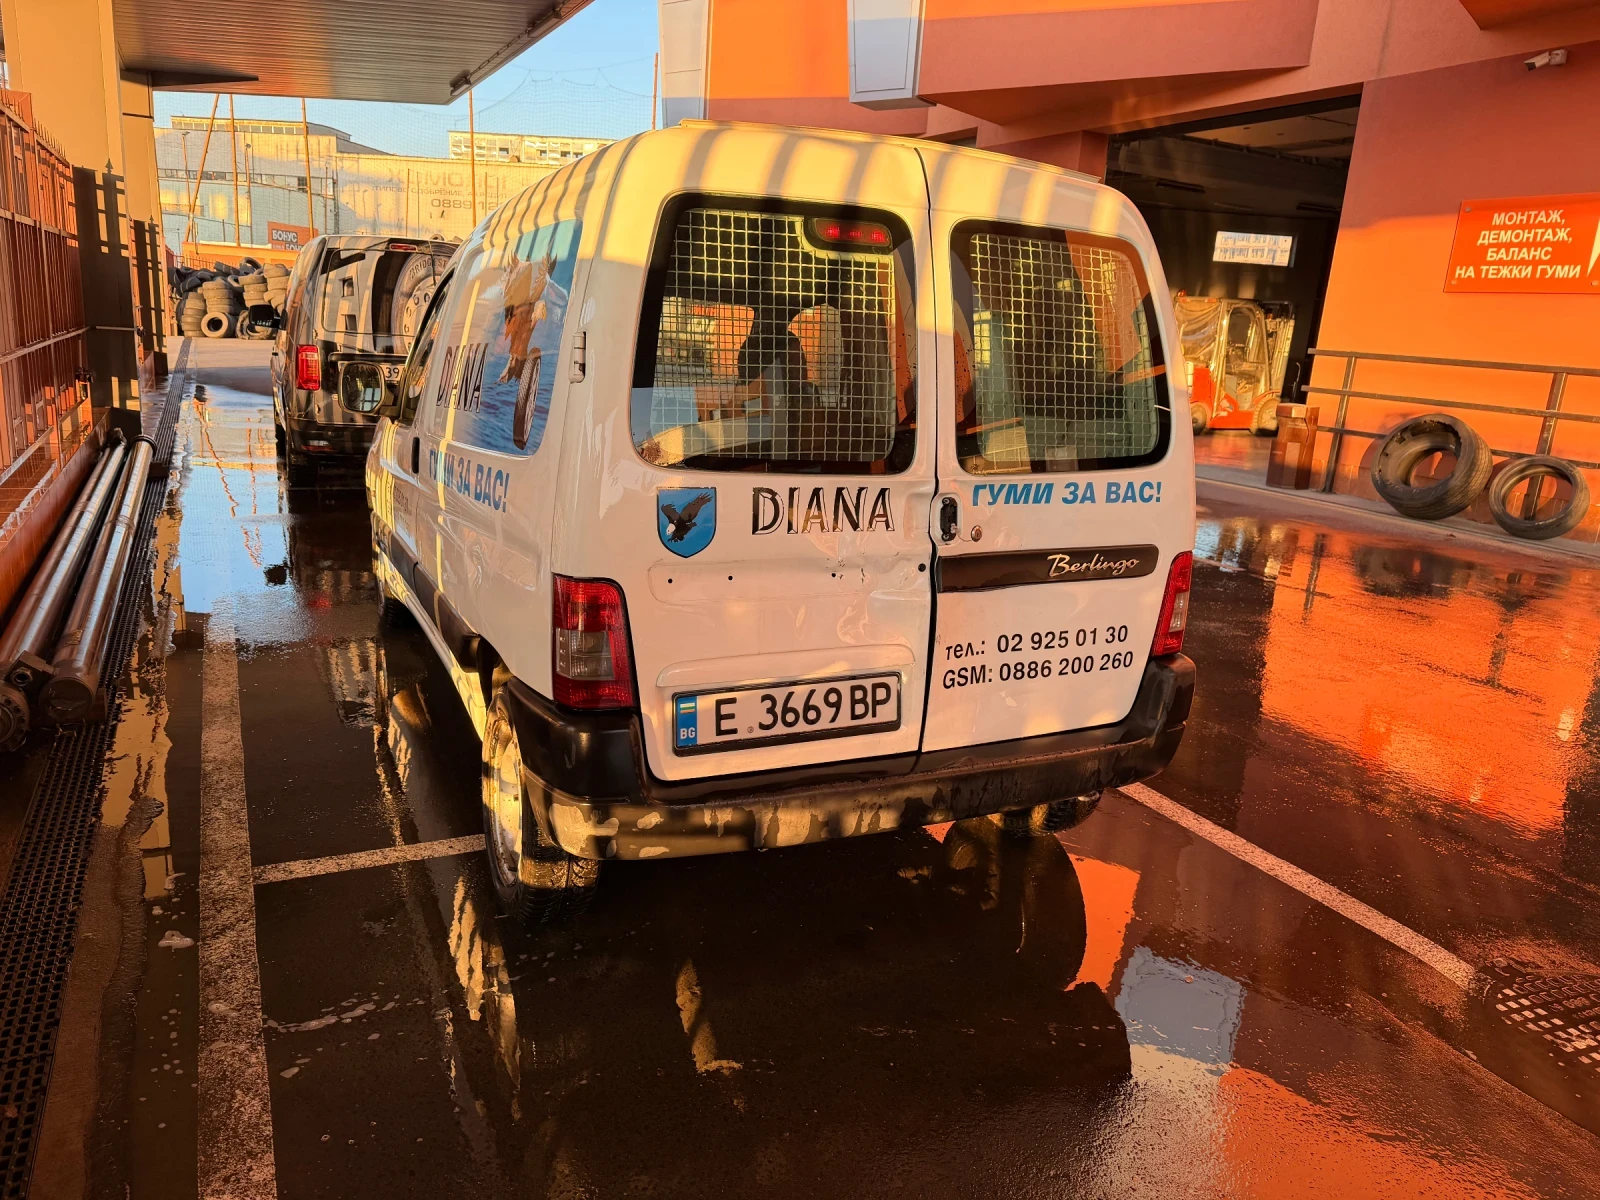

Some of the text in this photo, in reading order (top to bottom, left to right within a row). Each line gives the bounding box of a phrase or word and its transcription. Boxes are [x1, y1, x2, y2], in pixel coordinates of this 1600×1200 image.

[430, 198, 473, 210] 0889
[1491, 209, 1566, 226] МОНТАЖ,
[271, 229, 298, 243] БОНУС
[1476, 227, 1573, 246] ДЕМОНТАЖ,
[1486, 247, 1553, 261] БАЛАНС
[1455, 264, 1582, 279] НА ТЕЖКИ ГУМИ
[385, 366, 400, 379] 39
[436, 343, 489, 413] DIANA
[429, 449, 455, 488] ГУМИ
[456, 457, 471, 498] ЗА
[474, 463, 510, 513] ВАС!
[972, 481, 1163, 506] ГУМИ ЗА ВАС!
[752, 486, 895, 535] DIANA
[1047, 553, 1140, 577] Berlingo
[997, 633, 1023, 653] 02
[1030, 631, 1069, 650] 925
[1075, 628, 1098, 647] 01
[1105, 624, 1129, 644] 30
[942, 651, 1134, 690] GSM: 0886 200 260
[680, 727, 696, 740] BG
